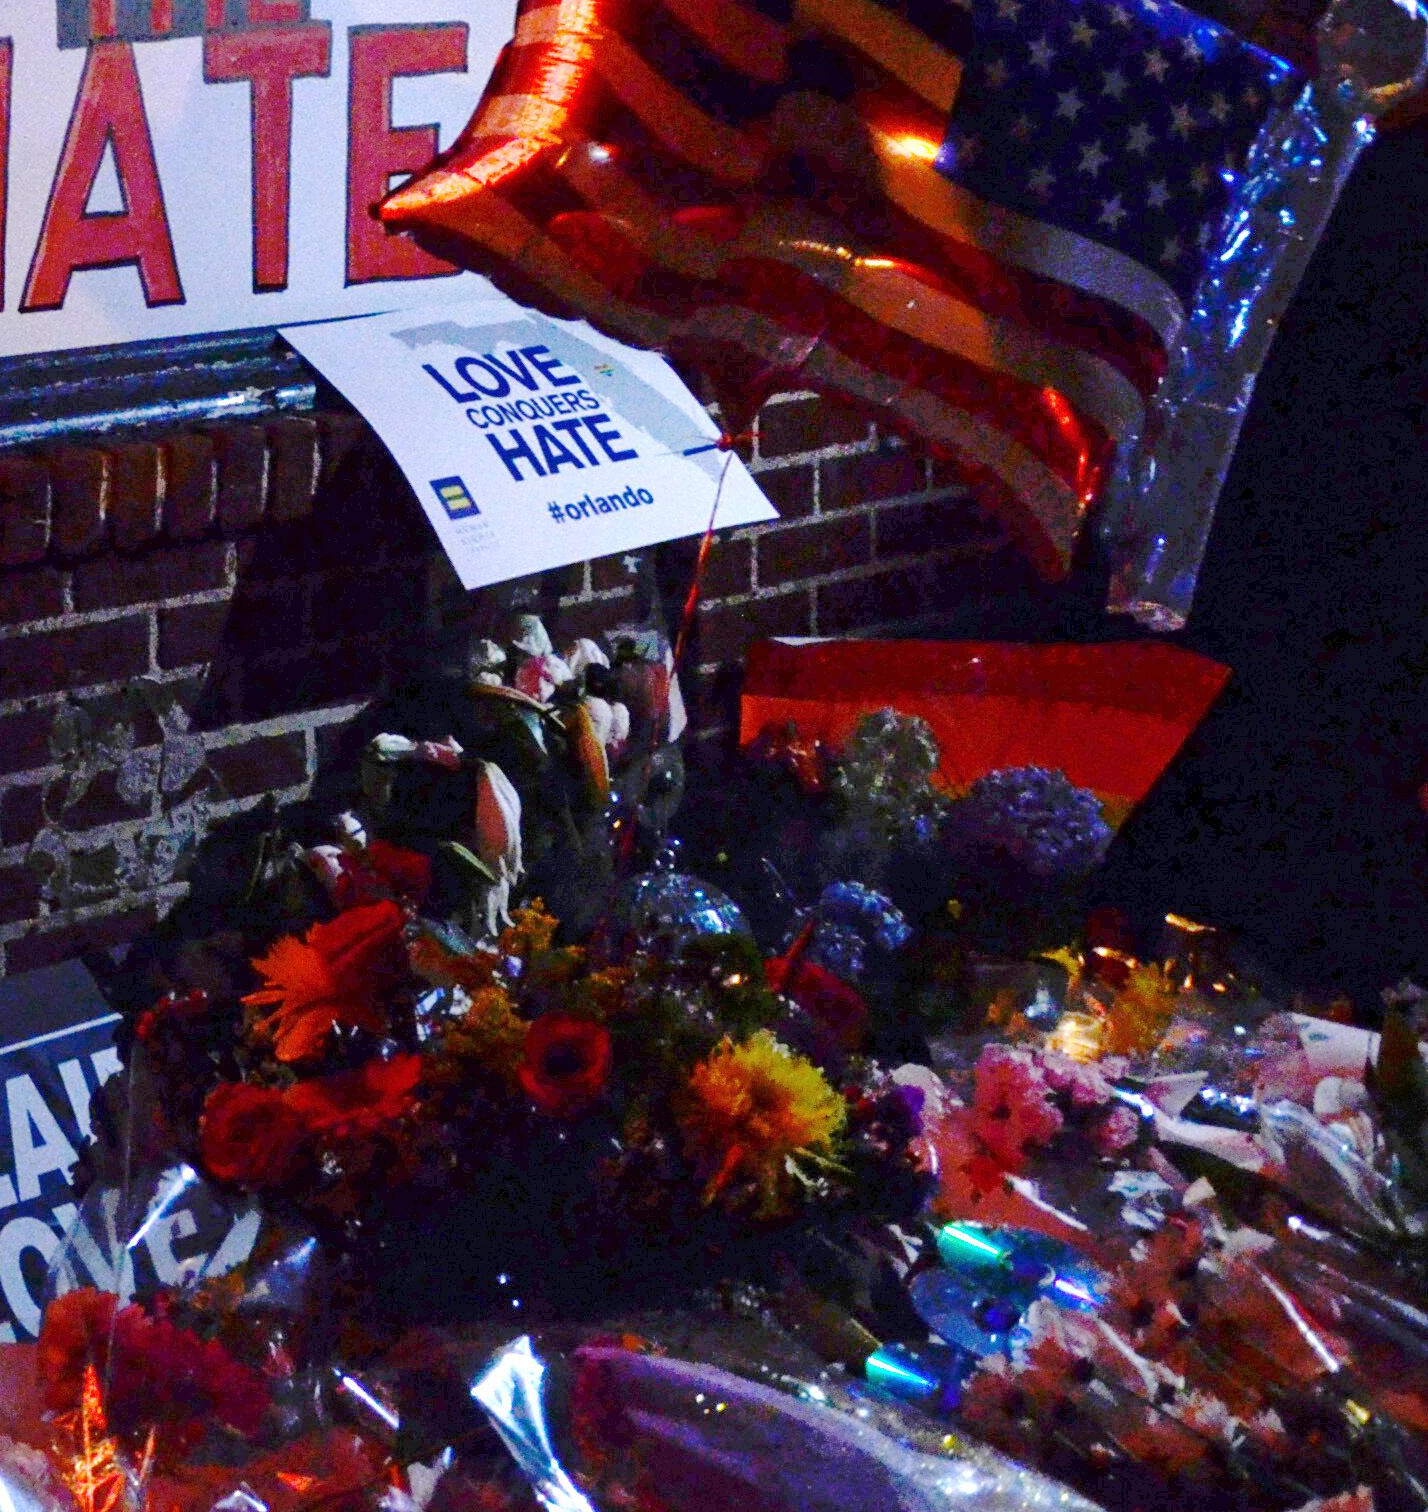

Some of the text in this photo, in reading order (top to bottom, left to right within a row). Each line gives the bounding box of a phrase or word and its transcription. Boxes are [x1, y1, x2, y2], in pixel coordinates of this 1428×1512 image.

[422, 344, 583, 404] LOVE
[465, 388, 600, 430] CONQUERS
[485, 413, 639, 482] HATE
[547, 486, 655, 525] #orlando
